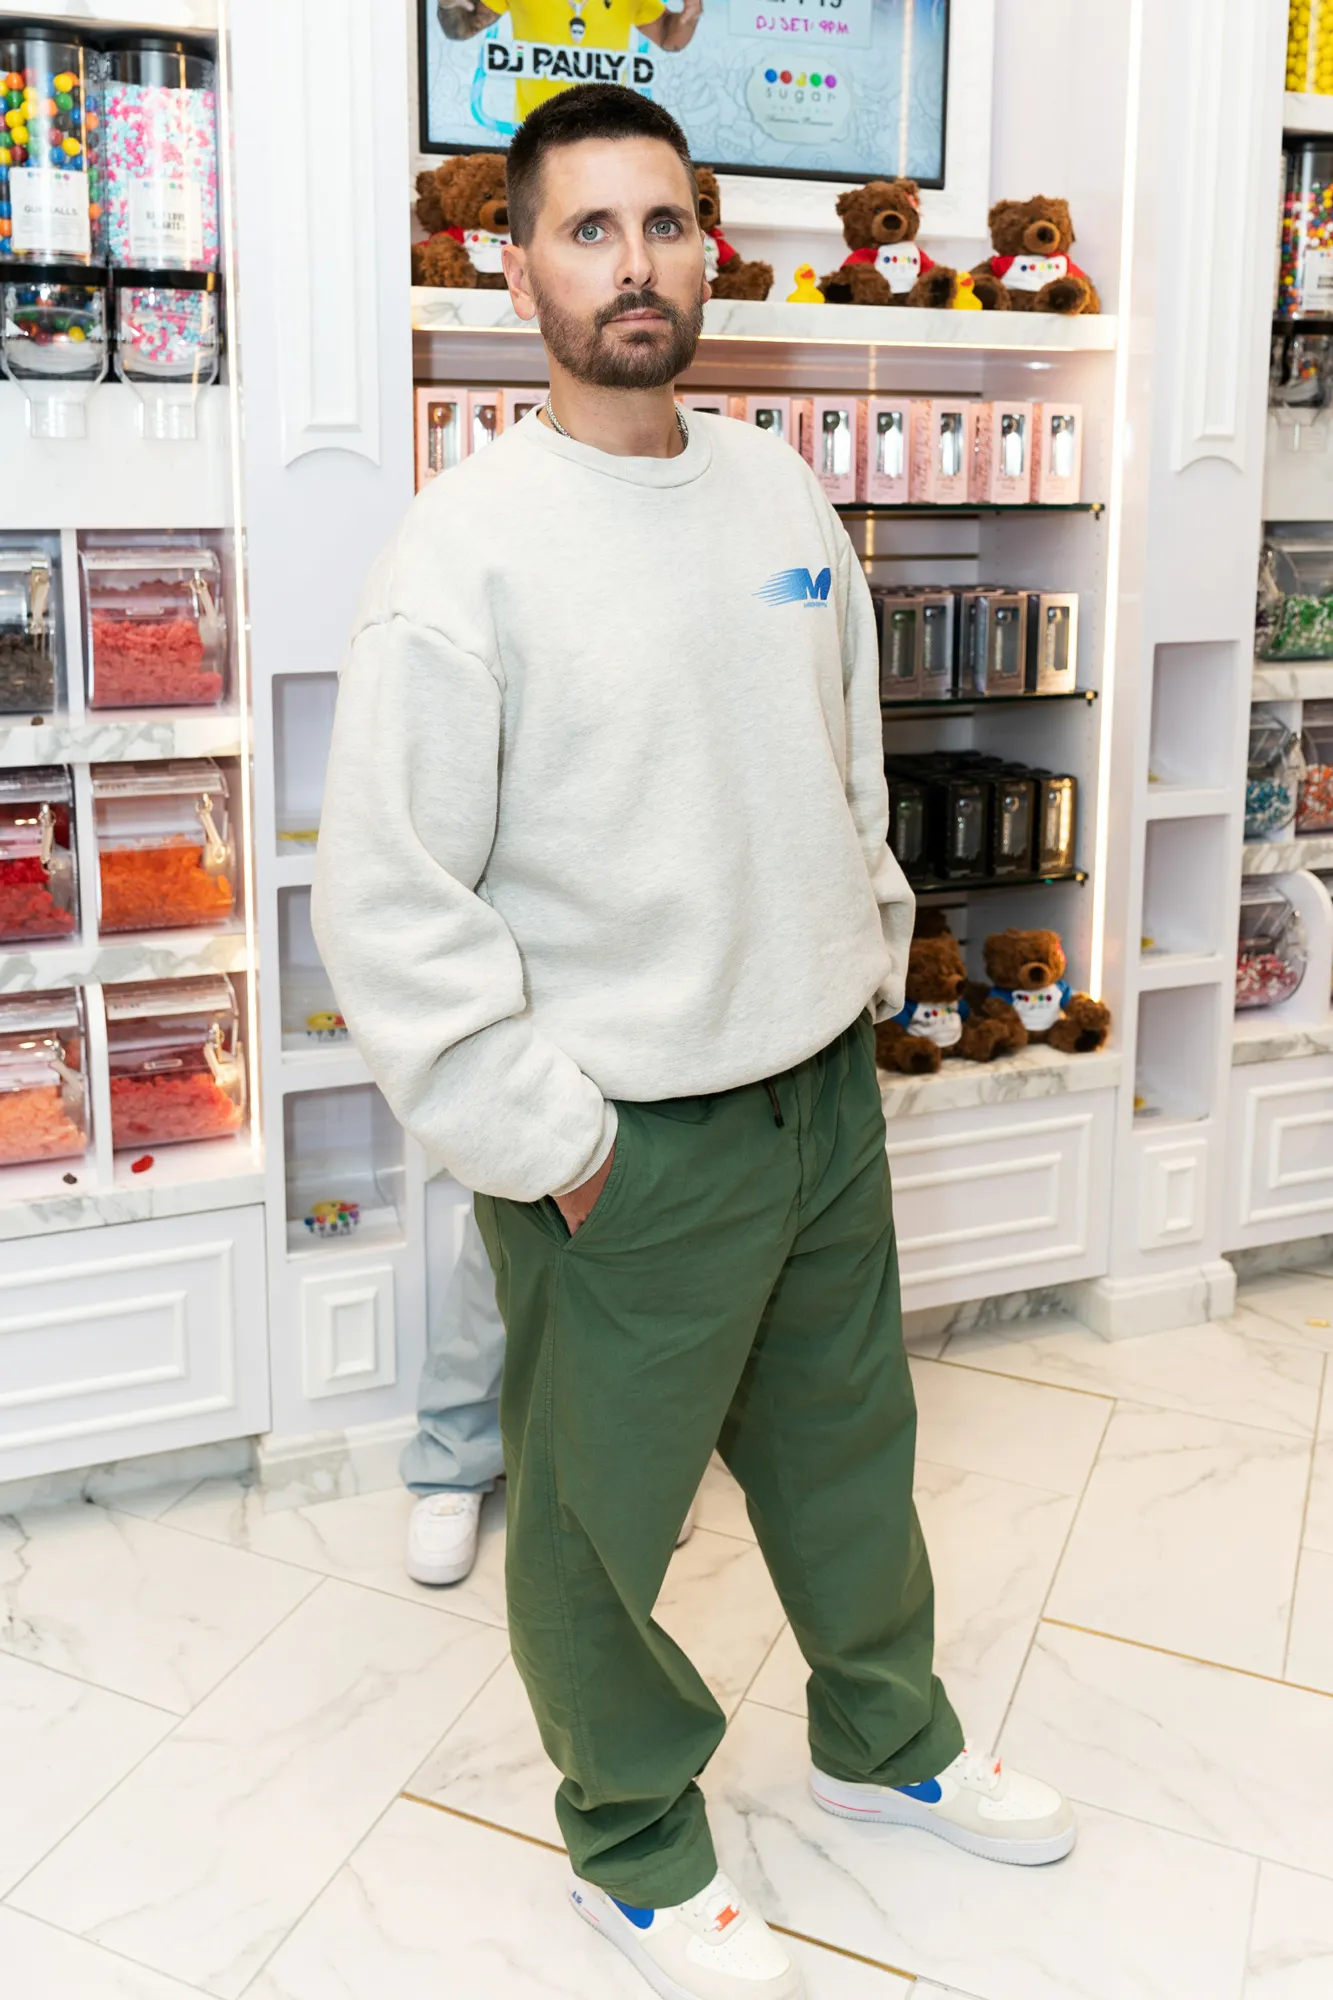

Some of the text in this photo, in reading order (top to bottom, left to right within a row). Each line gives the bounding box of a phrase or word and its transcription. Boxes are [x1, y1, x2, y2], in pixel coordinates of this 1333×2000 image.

[755, 15, 775, 30] DJ
[533, 47, 626, 81] PAULY
[634, 57, 654, 84] D
[766, 86, 837, 104] sugar
[24, 205, 78, 216] GUALLS
